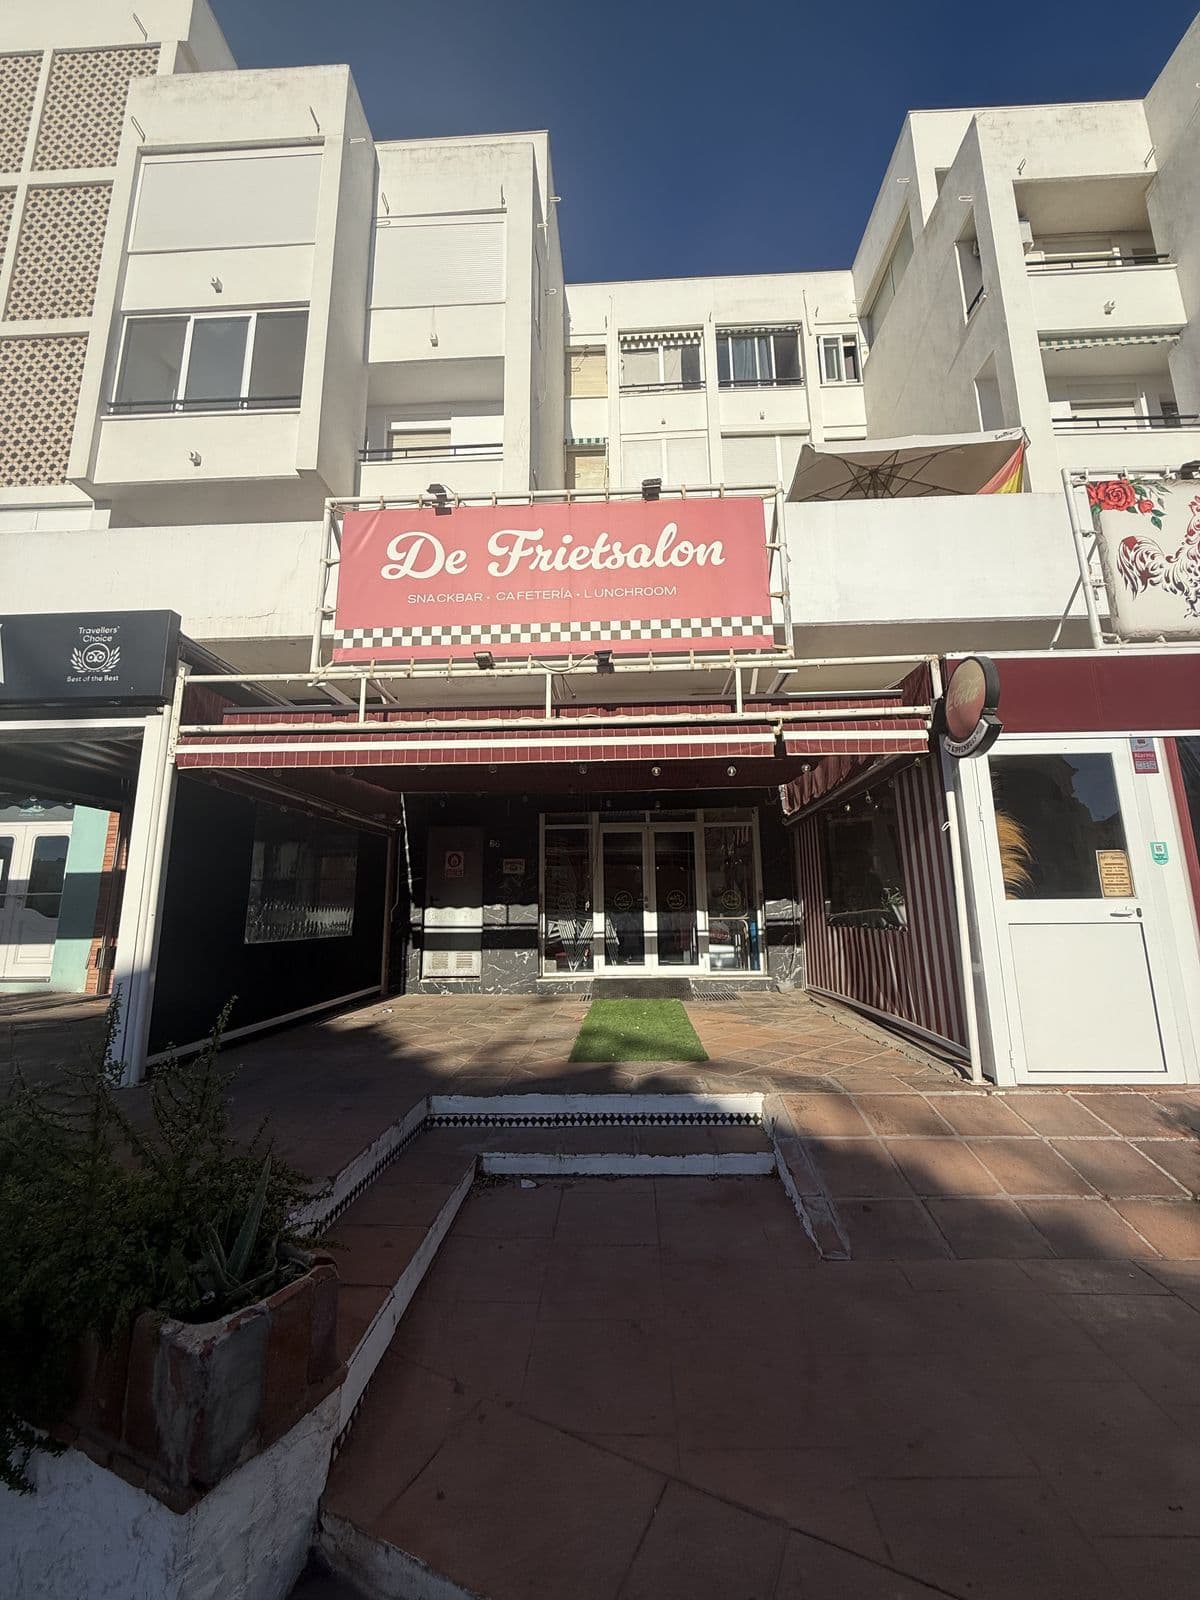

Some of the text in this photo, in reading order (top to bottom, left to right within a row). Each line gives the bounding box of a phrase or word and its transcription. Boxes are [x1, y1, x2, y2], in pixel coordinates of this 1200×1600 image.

[380, 522, 726, 580] De Frietsalon
[407, 586, 677, 604] SNACKBAR CAFETERÍA LUNCHROOM
[82, 634, 113, 643] Choice
[104, 674, 119, 682] Best
